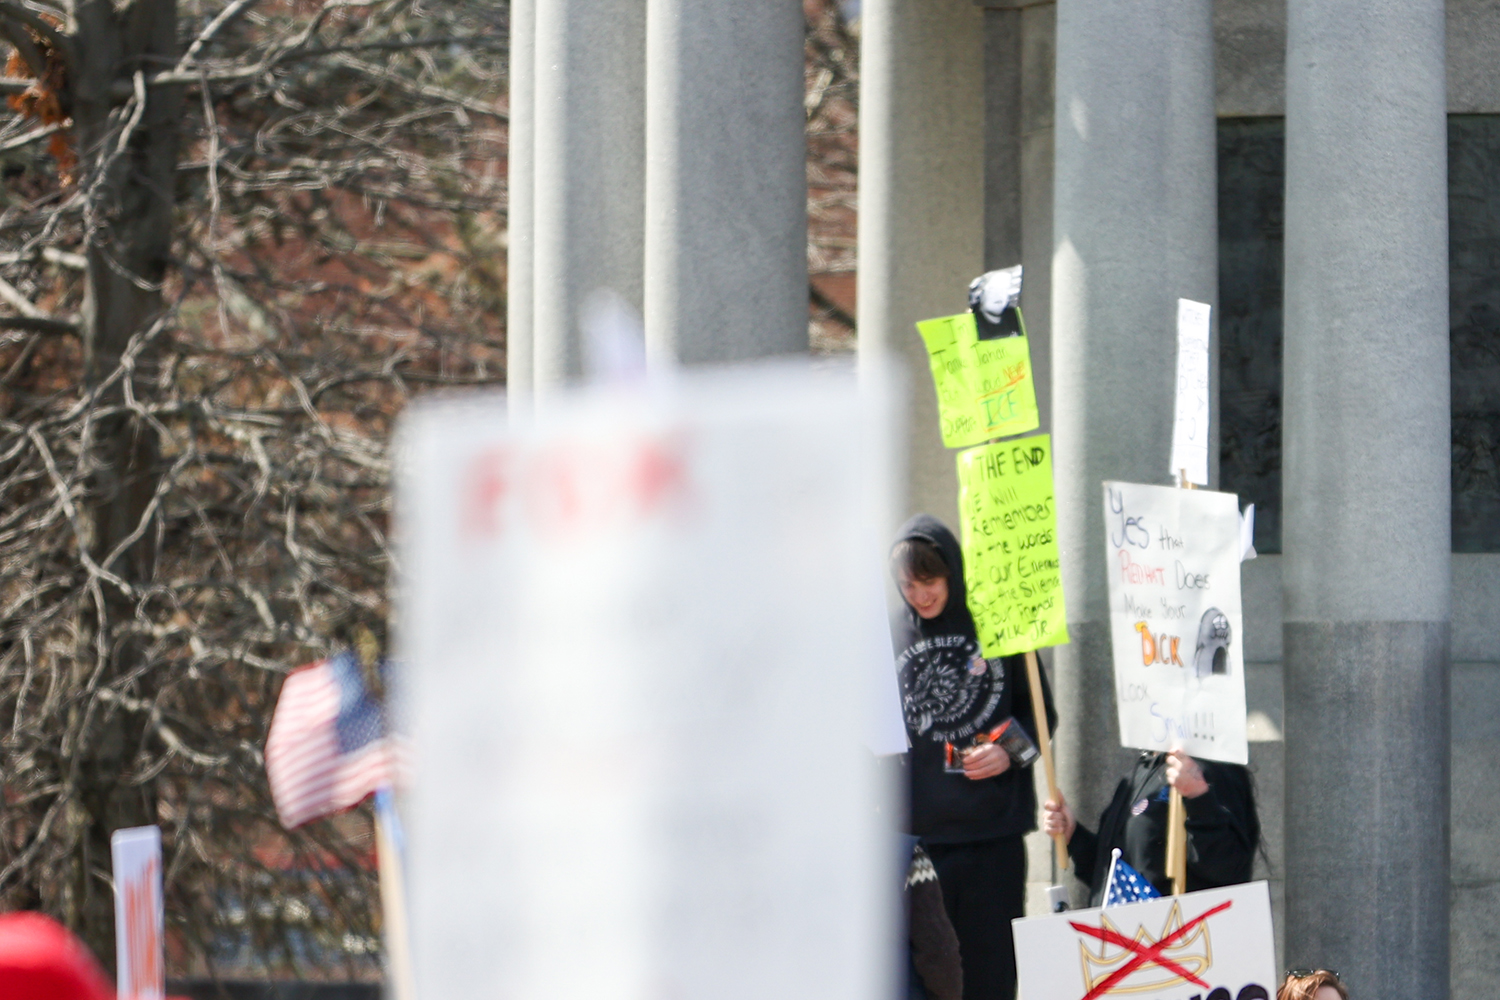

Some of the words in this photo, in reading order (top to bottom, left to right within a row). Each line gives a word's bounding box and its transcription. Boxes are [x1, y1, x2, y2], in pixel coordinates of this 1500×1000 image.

[981, 388, 1019, 428] ICE
[975, 451, 1006, 482] THE
[1012, 446, 1046, 476] END
[934, 634, 967, 648] SLEEP
